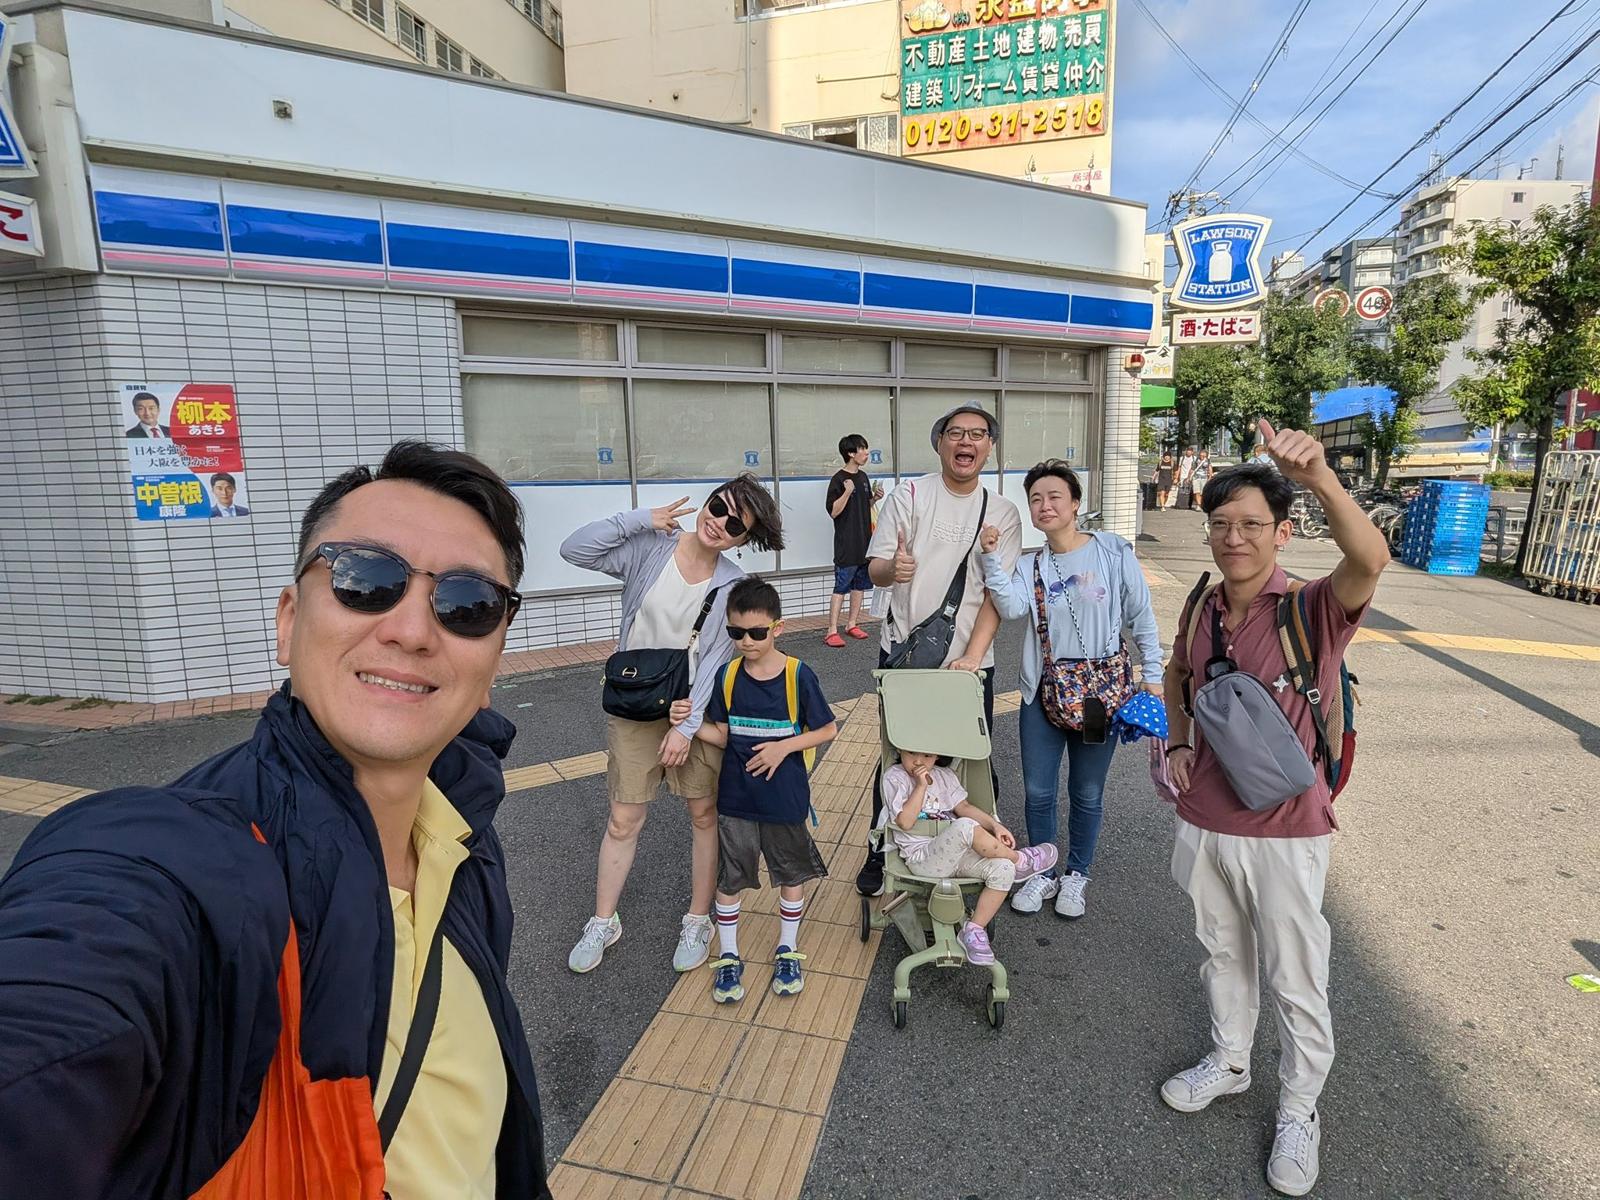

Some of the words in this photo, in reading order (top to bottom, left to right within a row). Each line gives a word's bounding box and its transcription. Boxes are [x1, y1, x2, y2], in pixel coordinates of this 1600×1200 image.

[905, 36, 966, 71] 不動産
[973, 31, 1011, 62] 土地
[1017, 22, 1058, 56] 建物
[1064, 15, 1102, 49] 売買
[905, 79, 944, 110] 建築
[950, 71, 1017, 101] リフォーム
[1021, 62, 1059, 95] 賃貸
[1064, 57, 1105, 91] 仲介
[905, 99, 1103, 147] 0120-31-2518
[1188, 227, 1255, 244] LAWSON
[1187, 278, 1252, 296] STATION
[176, 401, 232, 425] 柳本
[188, 425, 225, 436] あきら
[134, 444, 188, 456] 日本を強く
[136, 480, 203, 507] 中曽根
[159, 505, 187, 517] 康隆
